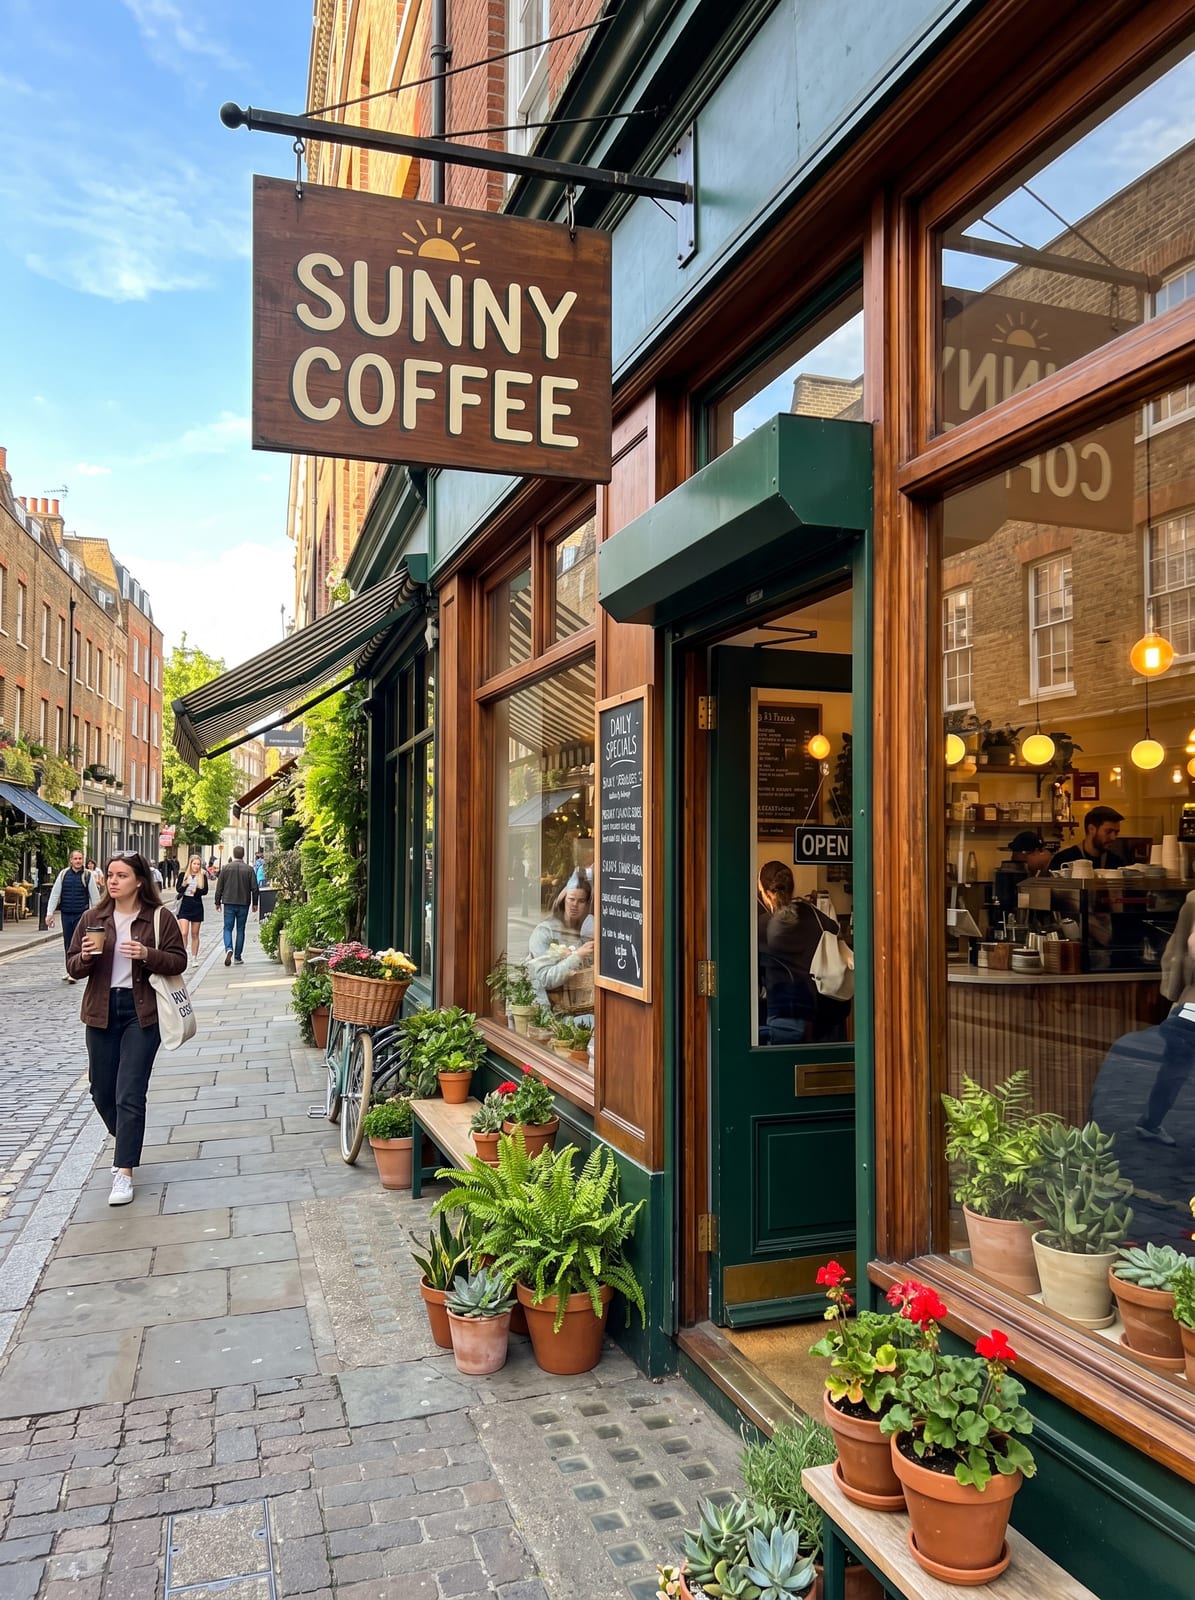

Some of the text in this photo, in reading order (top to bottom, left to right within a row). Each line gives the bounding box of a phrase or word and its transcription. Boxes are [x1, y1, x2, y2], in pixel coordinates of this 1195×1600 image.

[296, 252, 578, 360] SUNNY
[291, 346, 580, 448] COFFEE
[610, 712, 632, 737] DAILY
[605, 735, 637, 761] SPECIALS
[801, 834, 849, 856] OPEN
